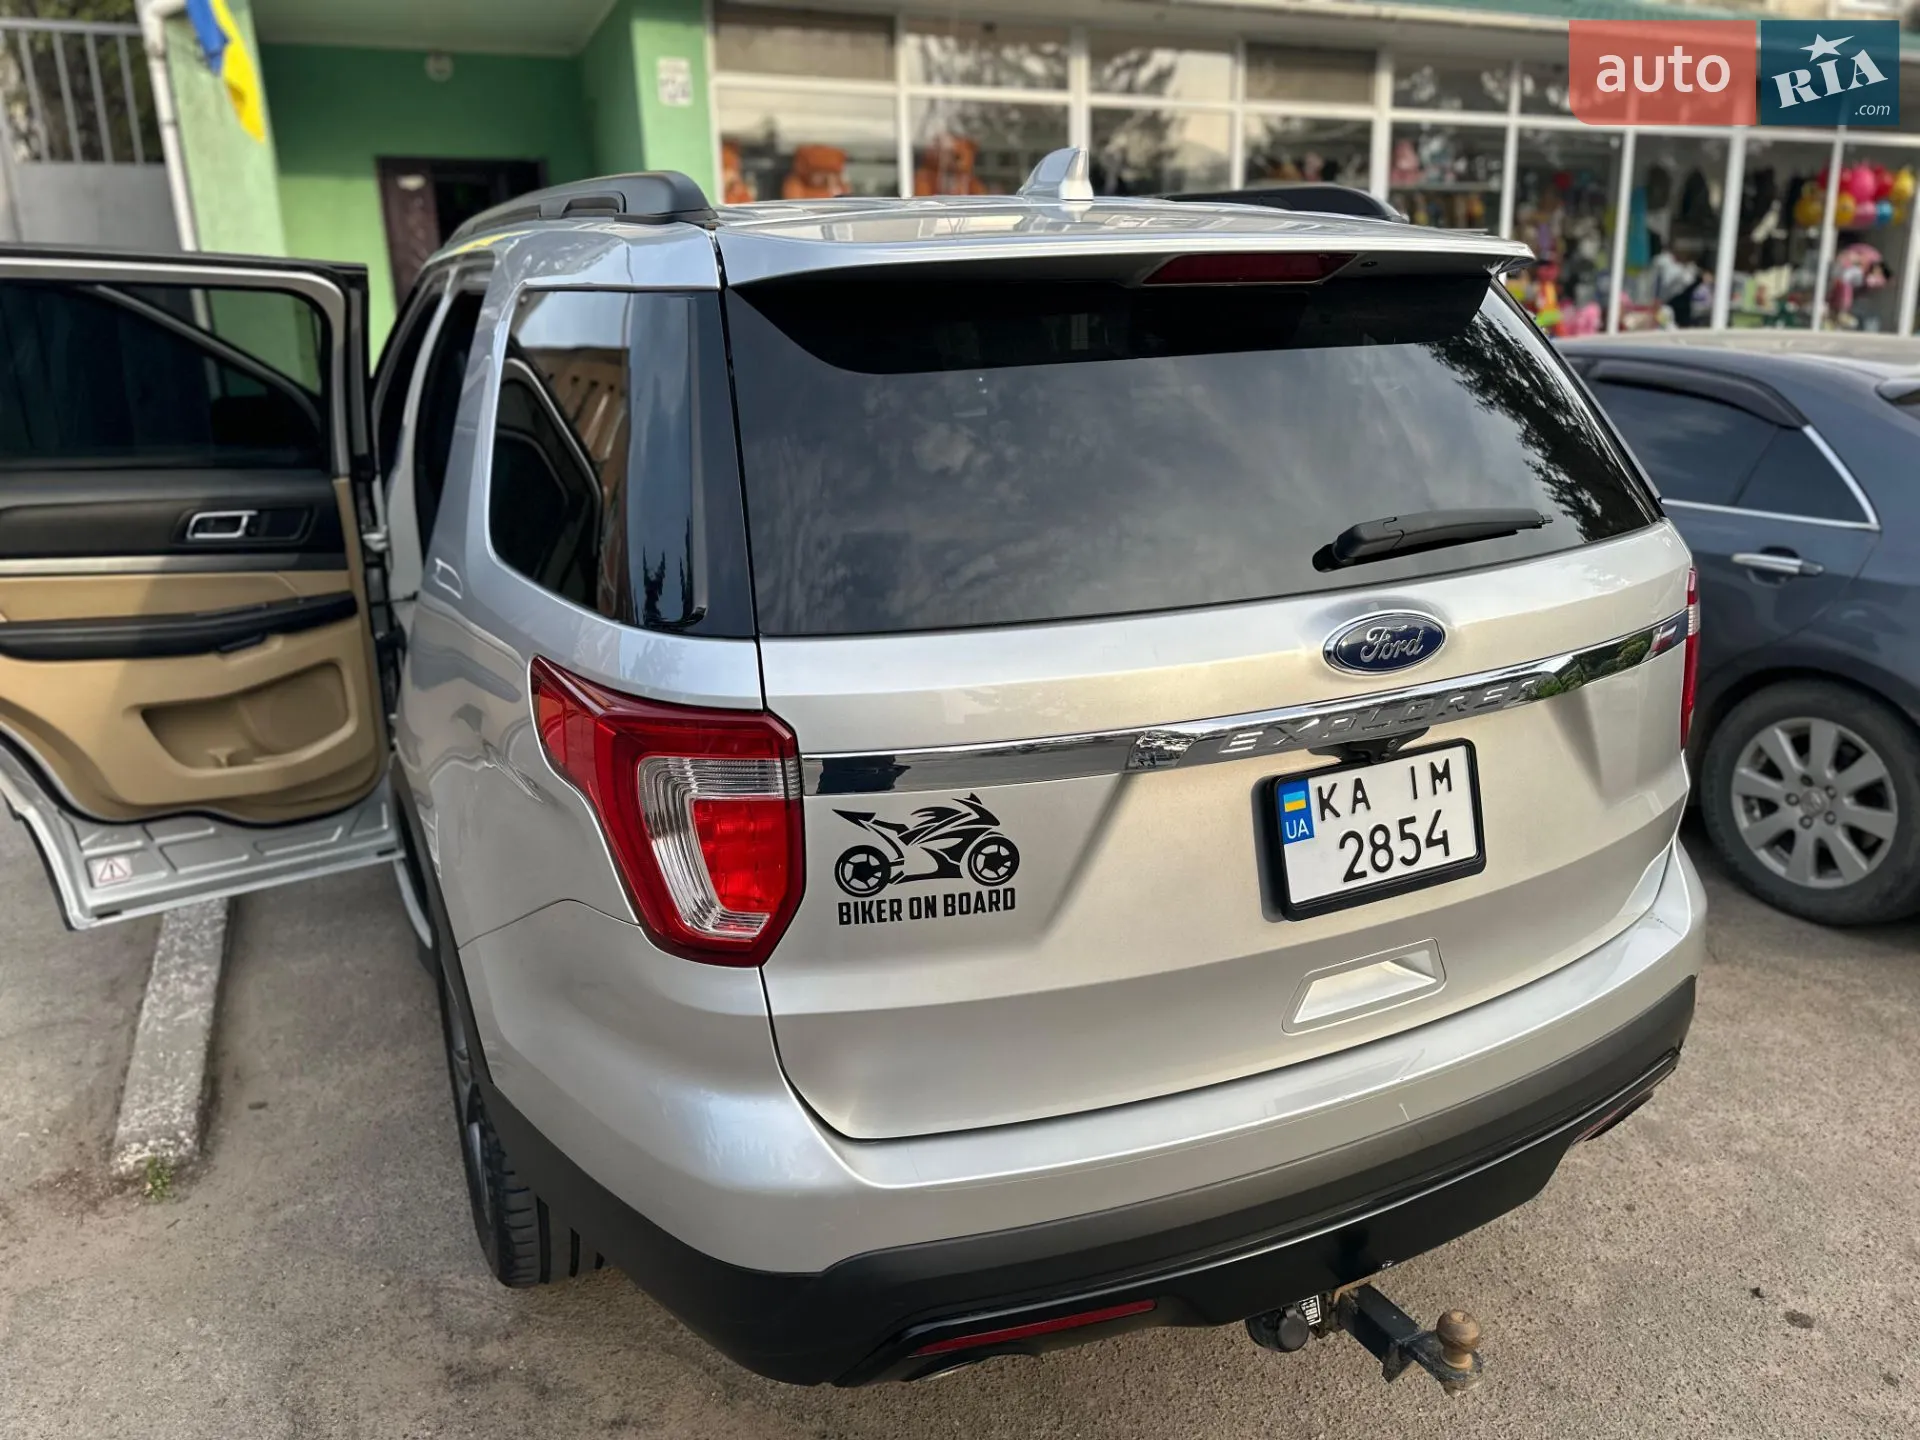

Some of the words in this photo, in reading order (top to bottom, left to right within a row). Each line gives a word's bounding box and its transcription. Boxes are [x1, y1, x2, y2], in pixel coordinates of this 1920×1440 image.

[1360, 624, 1424, 663] Ford
[1317, 777, 1372, 822] KA
[1410, 757, 1453, 801] IM
[1285, 817, 1310, 840] UA
[1338, 808, 1450, 883] 2854
[837, 898, 903, 926] BIKER
[908, 894, 938, 920] ON
[943, 887, 1017, 917] BOARD
